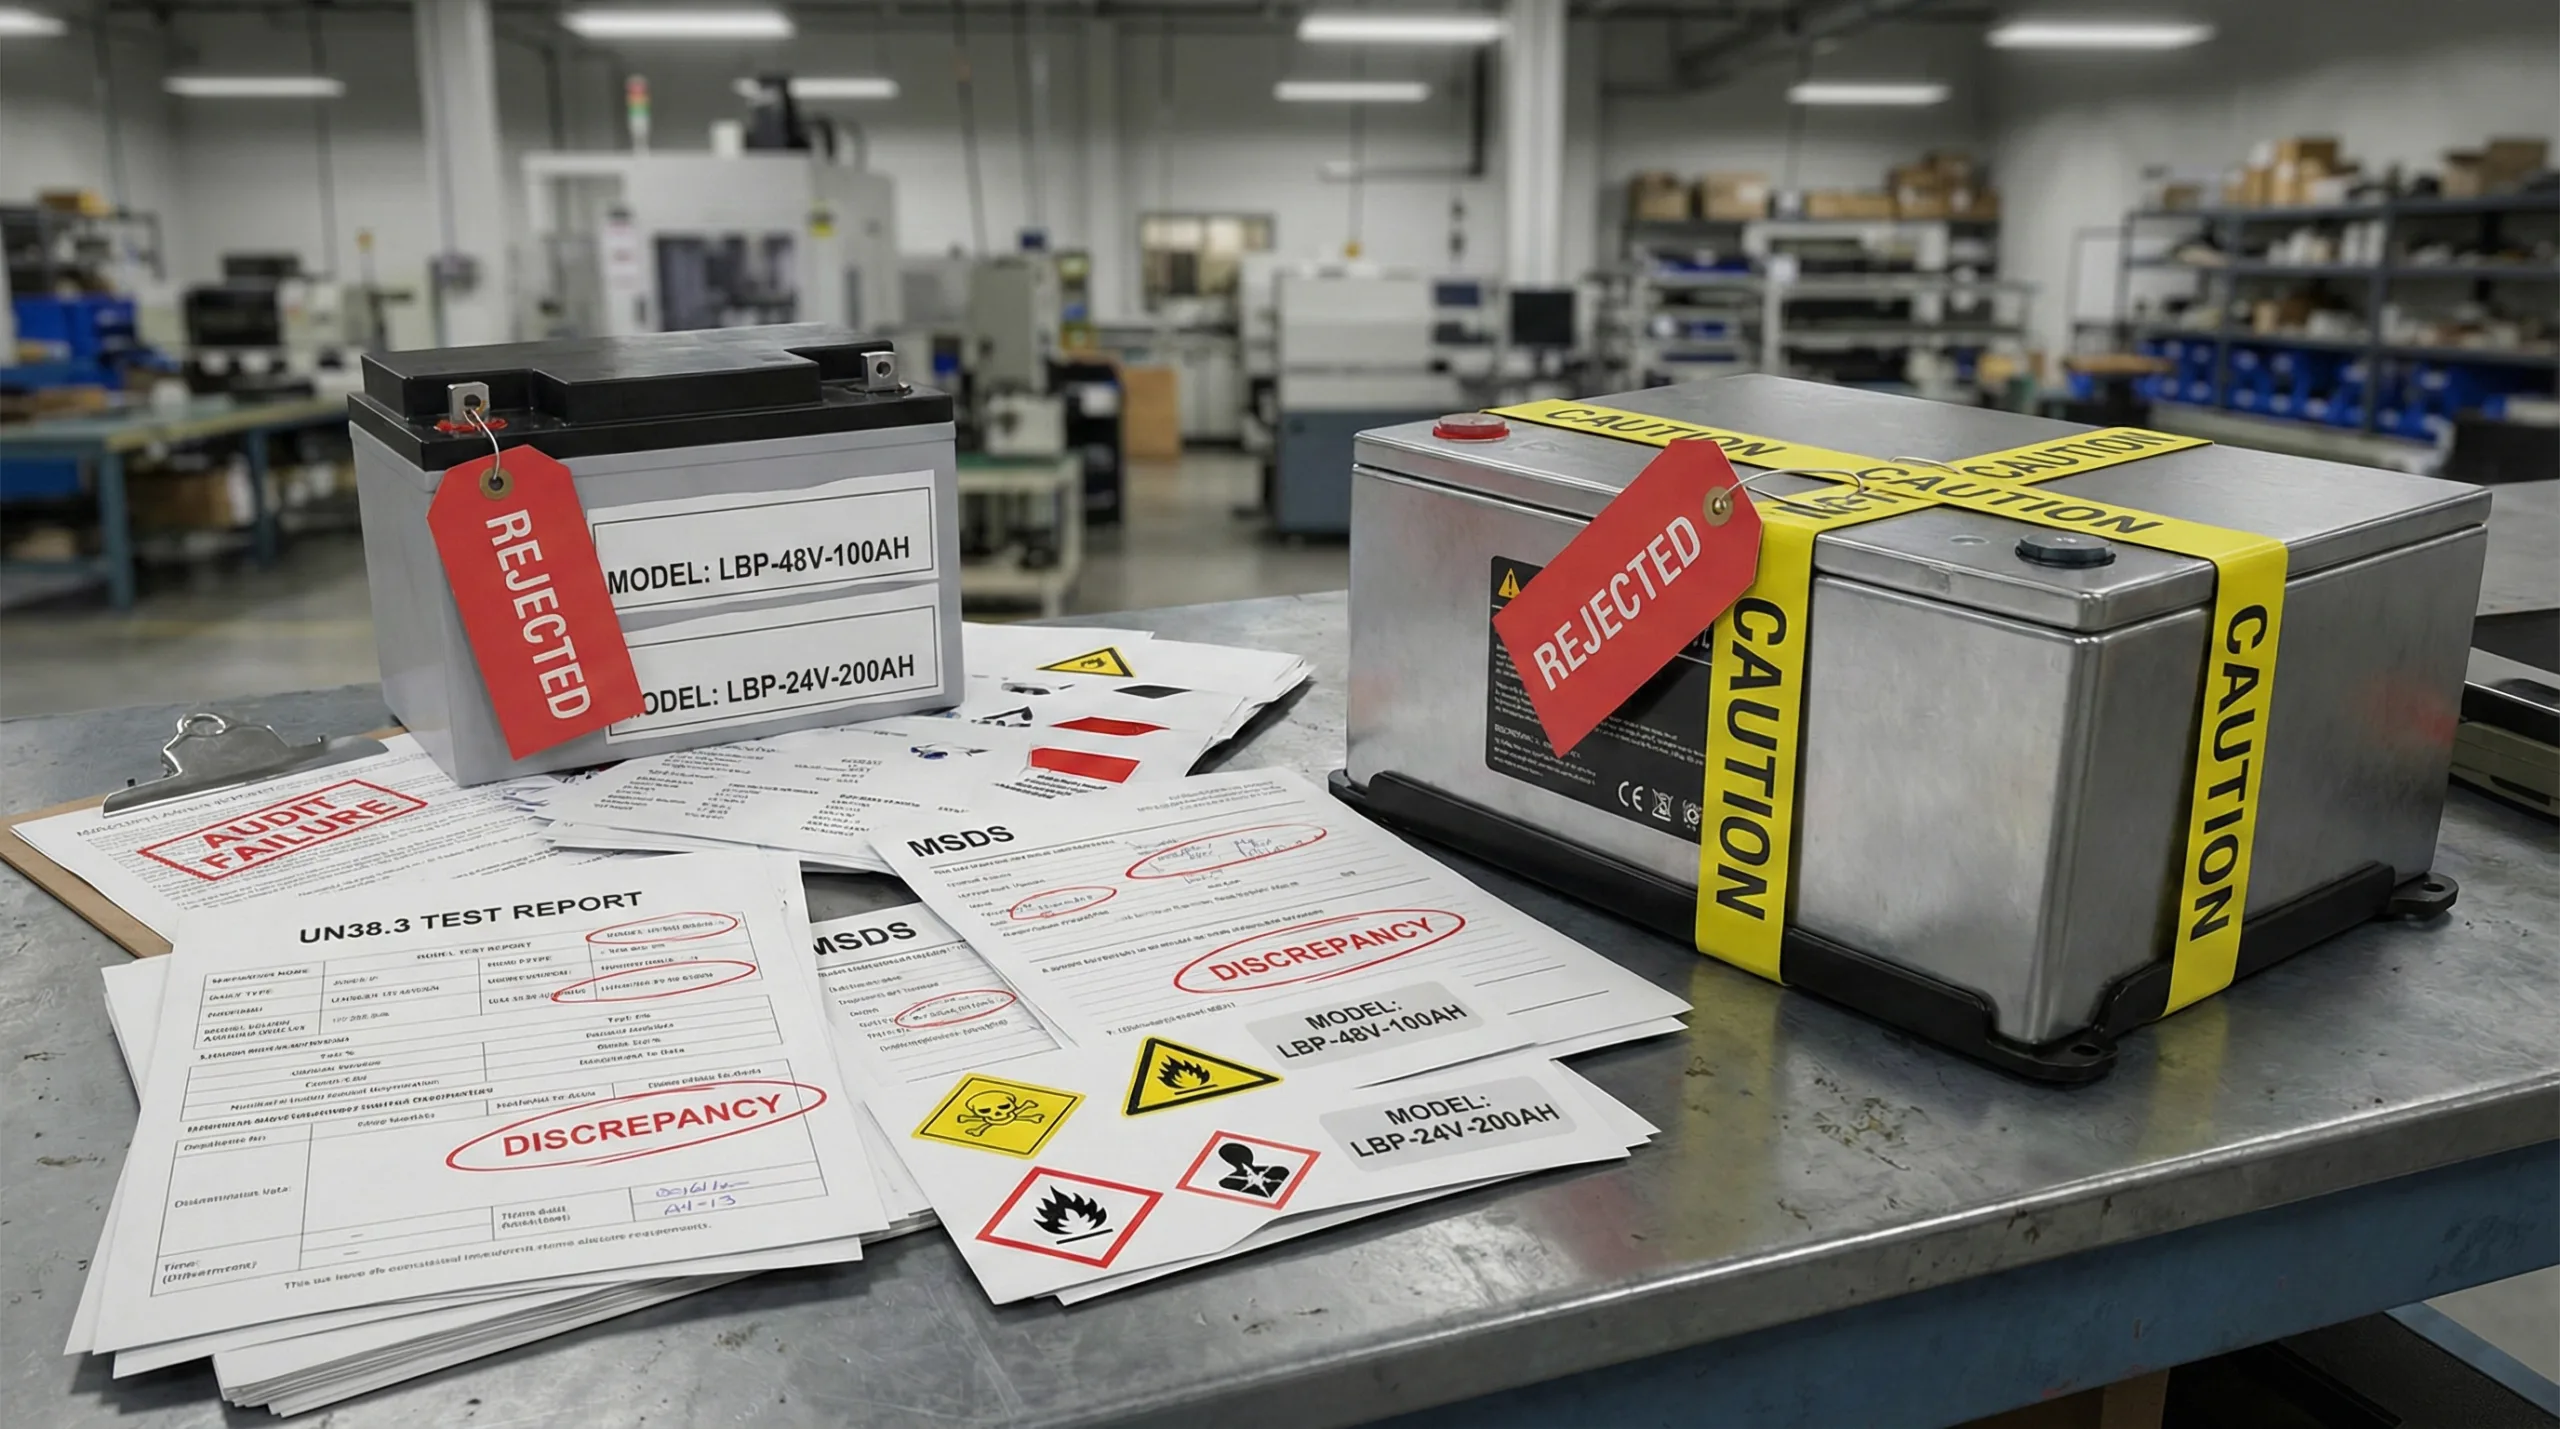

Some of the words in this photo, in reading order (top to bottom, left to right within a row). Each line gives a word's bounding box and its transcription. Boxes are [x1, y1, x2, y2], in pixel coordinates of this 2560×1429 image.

[1545, 408, 1787, 457] CAUTION
[1962, 430, 2178, 479] CAUTION
[1856, 466, 2164, 535] CAUTION
[607, 562, 711, 596] MODEL:
[719, 535, 911, 582] LBP-48V-100AH
[485, 508, 591, 720] REJECTED
[1532, 513, 1702, 692] REJECTED
[628, 684, 719, 718] ODEL:
[726, 654, 915, 705] LBP-24V-200AH
[1715, 597, 1788, 922] CAUTION
[2189, 603, 2268, 943] CAUTION
[200, 796, 340, 849] AUDIT
[200, 797, 399, 870] FAILURE
[907, 818, 1016, 858] MSDS
[300, 918, 411, 944] UN38.3
[420, 907, 502, 930] TEST
[513, 891, 642, 920] REPORT
[813, 921, 917, 956] MSDS
[1209, 917, 1435, 983] DISCREPANCY
[1276, 1002, 1468, 1061] LBP-48V-100AH
[1305, 997, 1403, 1032] MODEL:
[503, 1093, 782, 1157] DISCREPANCY
[1350, 1103, 1560, 1159] LBP-24V-200AH
[1385, 1093, 1491, 1127] MODEL:
